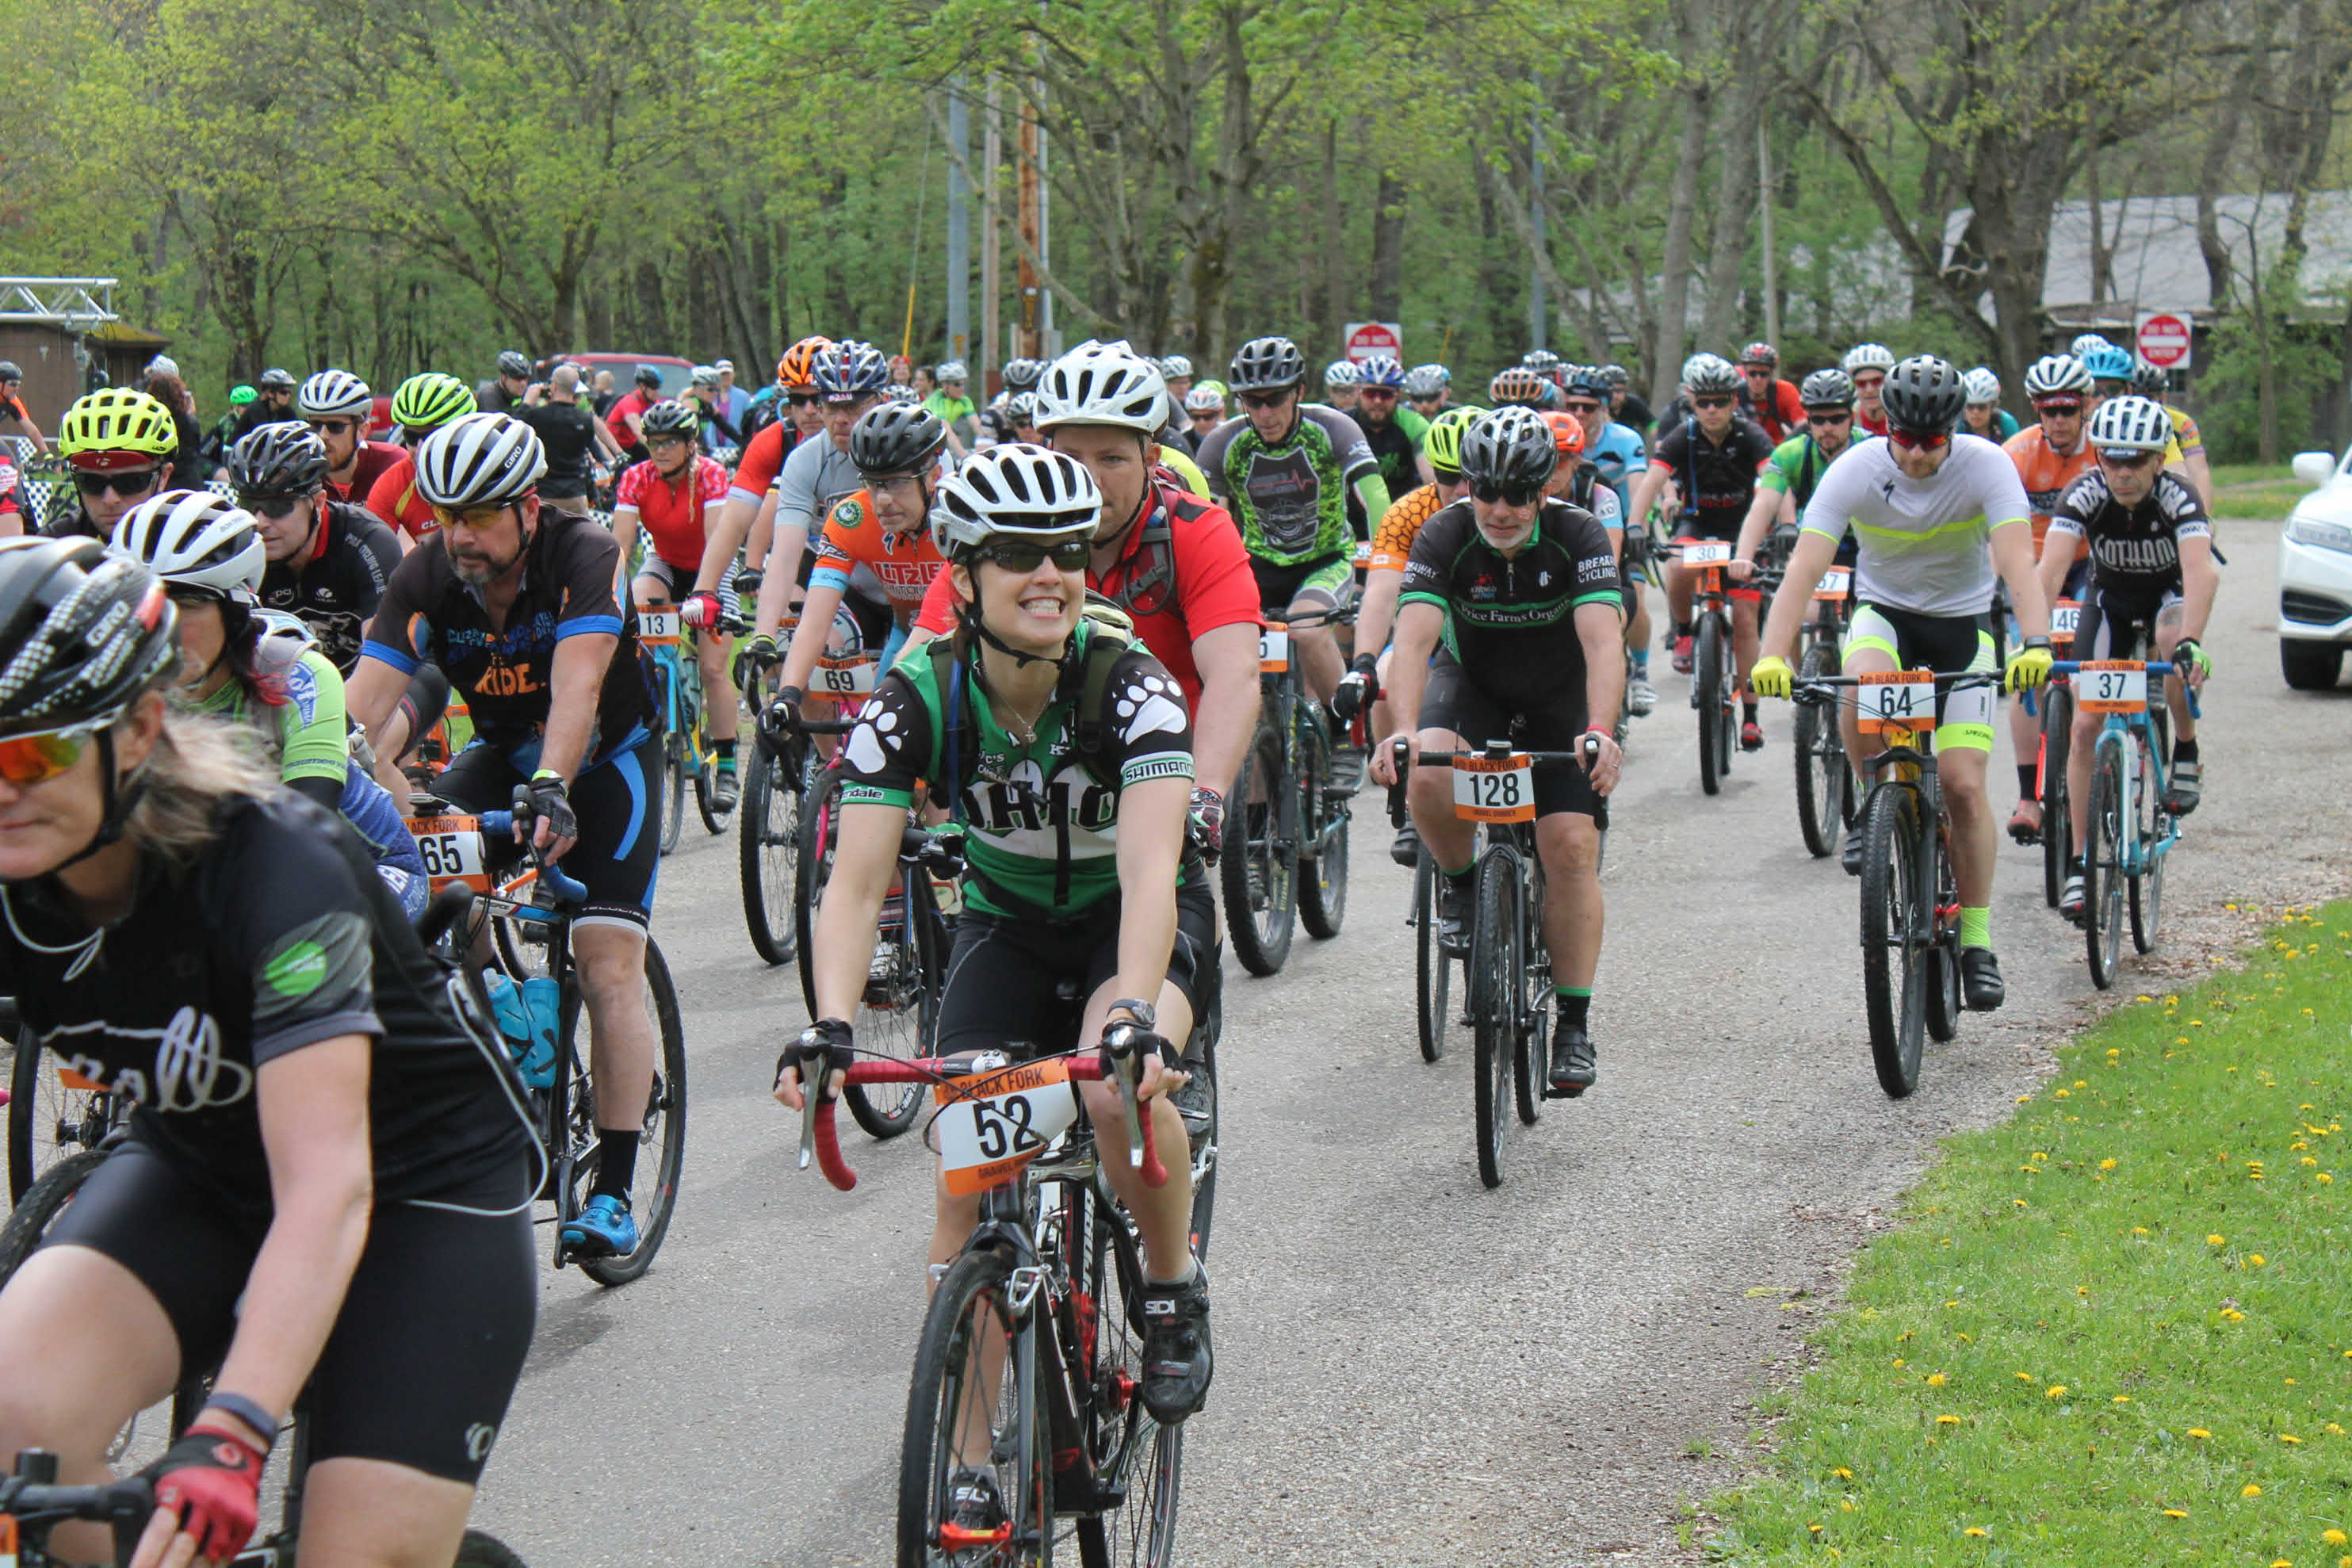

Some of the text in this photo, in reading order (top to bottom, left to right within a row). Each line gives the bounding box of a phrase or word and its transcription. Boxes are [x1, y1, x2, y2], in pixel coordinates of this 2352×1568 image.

[504, 446, 523, 469] GIRO
[1696, 548, 1717, 561] 30
[2095, 534, 2177, 566] GOTHAM
[1578, 567, 1617, 583] CYCLING
[86, 601, 130, 648] GIRO
[646, 614, 664, 635] 13
[1490, 610, 1528, 623] Farms
[825, 670, 855, 691] 69
[1876, 674, 1922, 684] BLACK FORK
[2098, 672, 2126, 699] 37
[1880, 686, 1913, 717] 64
[1470, 759, 1519, 773] BLACK FORK
[1469, 772, 1520, 807] 128
[435, 818, 461, 832] FORK
[419, 834, 464, 876] 65
[1007, 1068, 1046, 1092] FORK
[973, 1095, 1041, 1159] 52
[1145, 1299, 1176, 1314] SIDI
